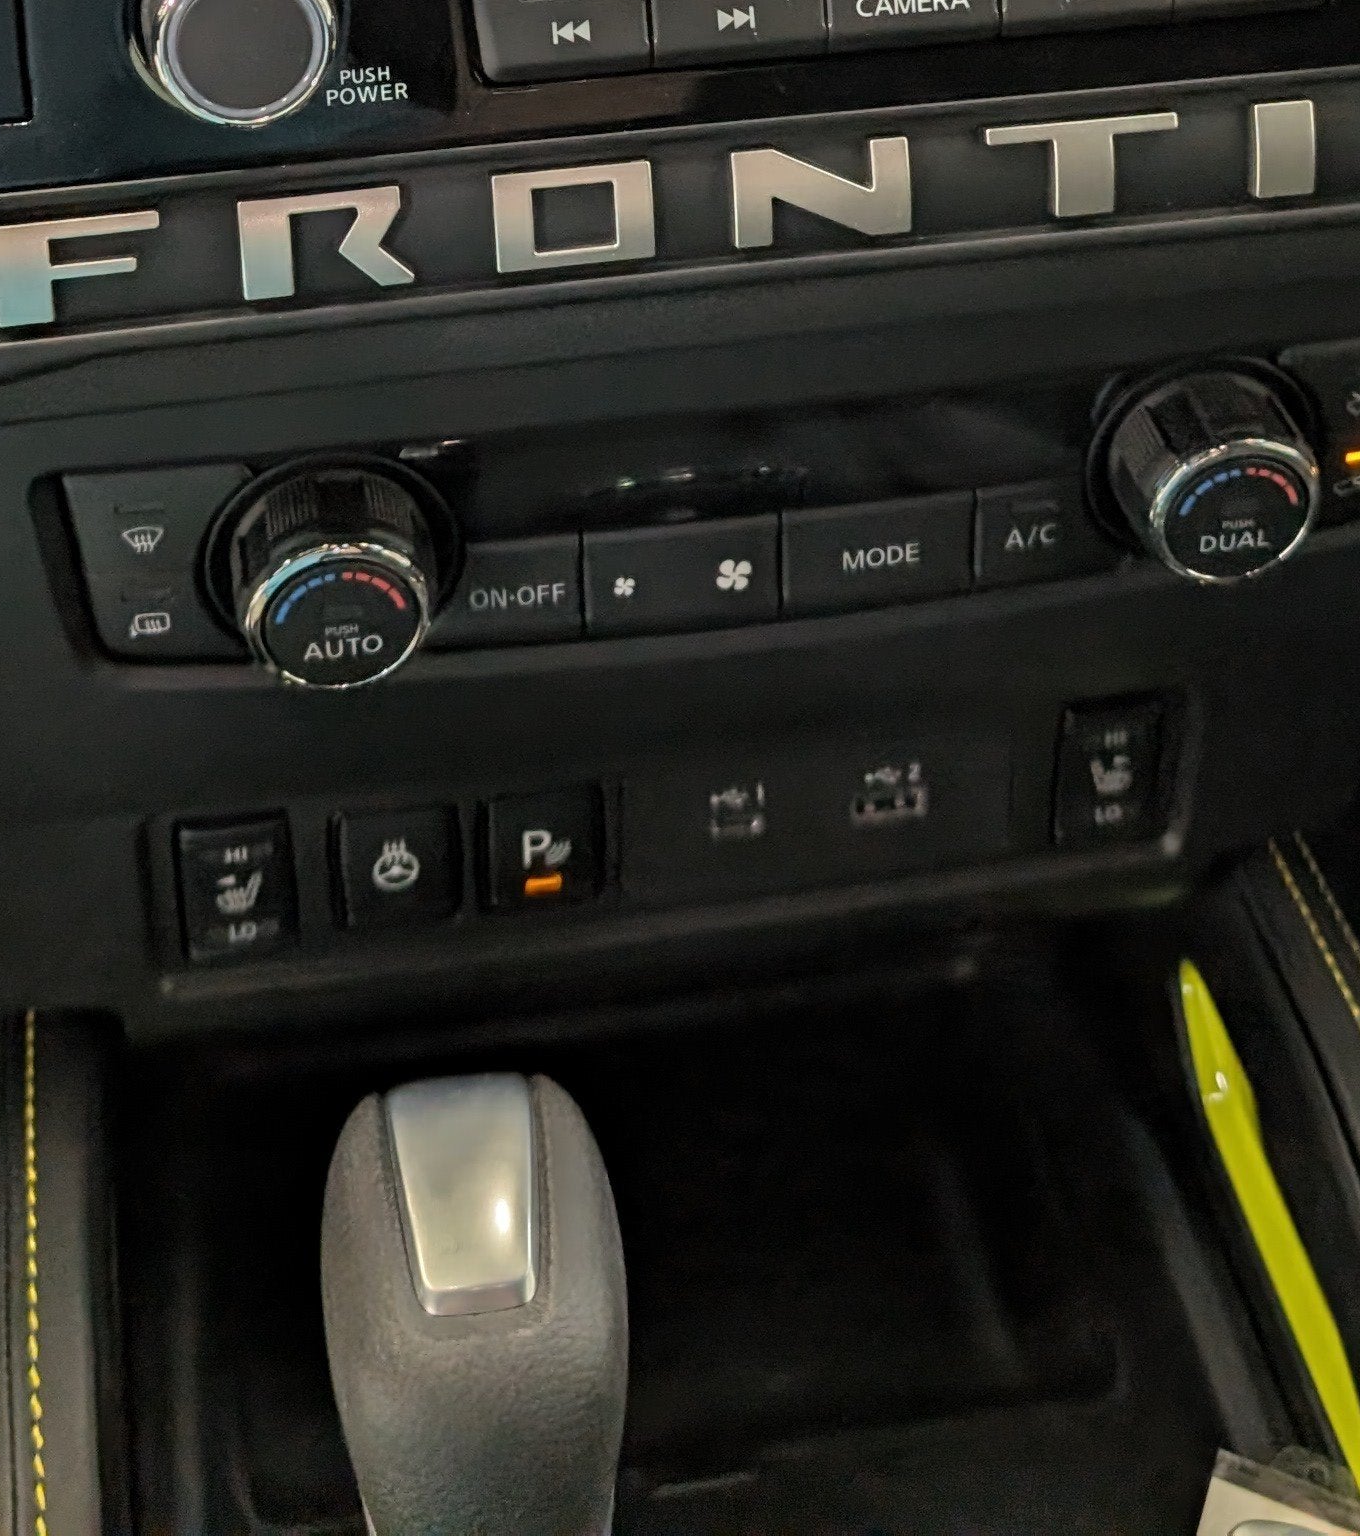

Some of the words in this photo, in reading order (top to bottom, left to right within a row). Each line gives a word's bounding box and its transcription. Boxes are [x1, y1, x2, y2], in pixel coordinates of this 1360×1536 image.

[340, 66, 391, 86] PUSH
[326, 82, 408, 107] POWER
[1004, 522, 1058, 552] A/C
[1199, 529, 1271, 554] DUAL
[842, 541, 921, 574] MODE
[303, 634, 384, 662] AUTO
